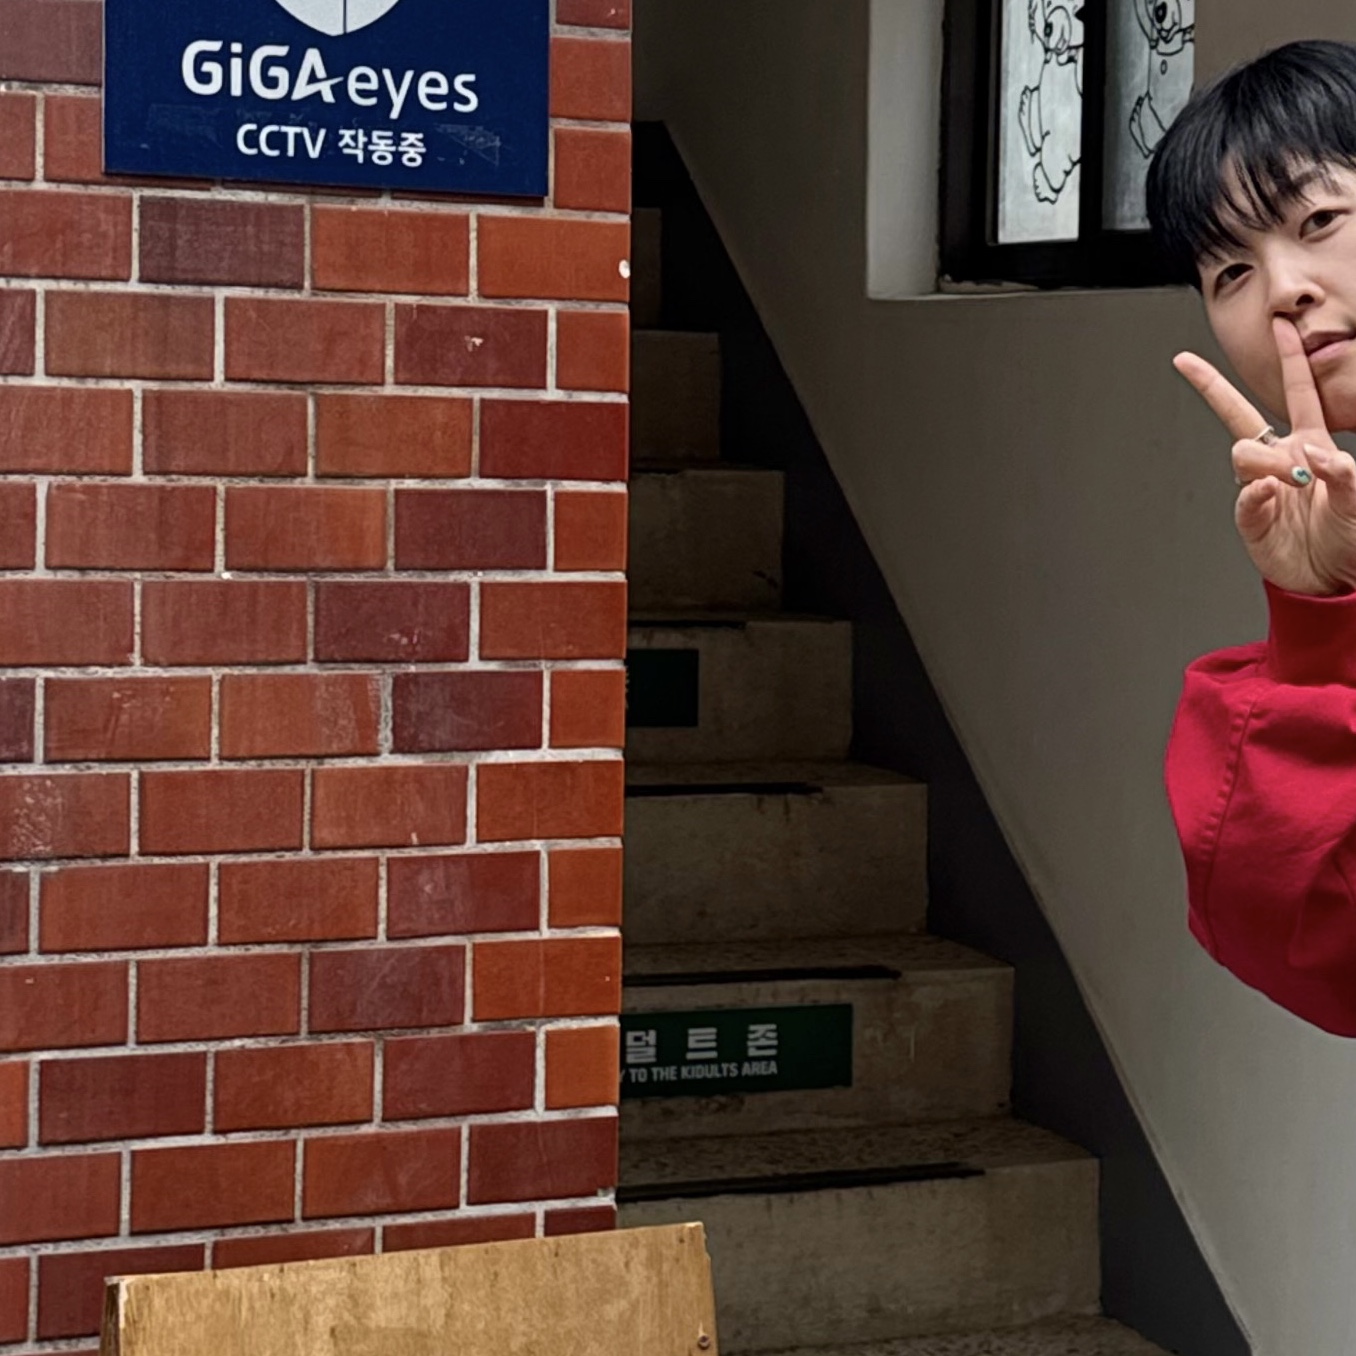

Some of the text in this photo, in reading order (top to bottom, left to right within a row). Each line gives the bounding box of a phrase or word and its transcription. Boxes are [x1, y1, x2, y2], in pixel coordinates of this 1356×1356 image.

[346, 63, 480, 120] eyes
[236, 123, 427, 168] CCTV 작동중
[629, 1067, 648, 1083] TO
[651, 1065, 678, 1081] THE
[680, 1062, 738, 1080] KIDULTS
[741, 1060, 778, 1076] AREA
